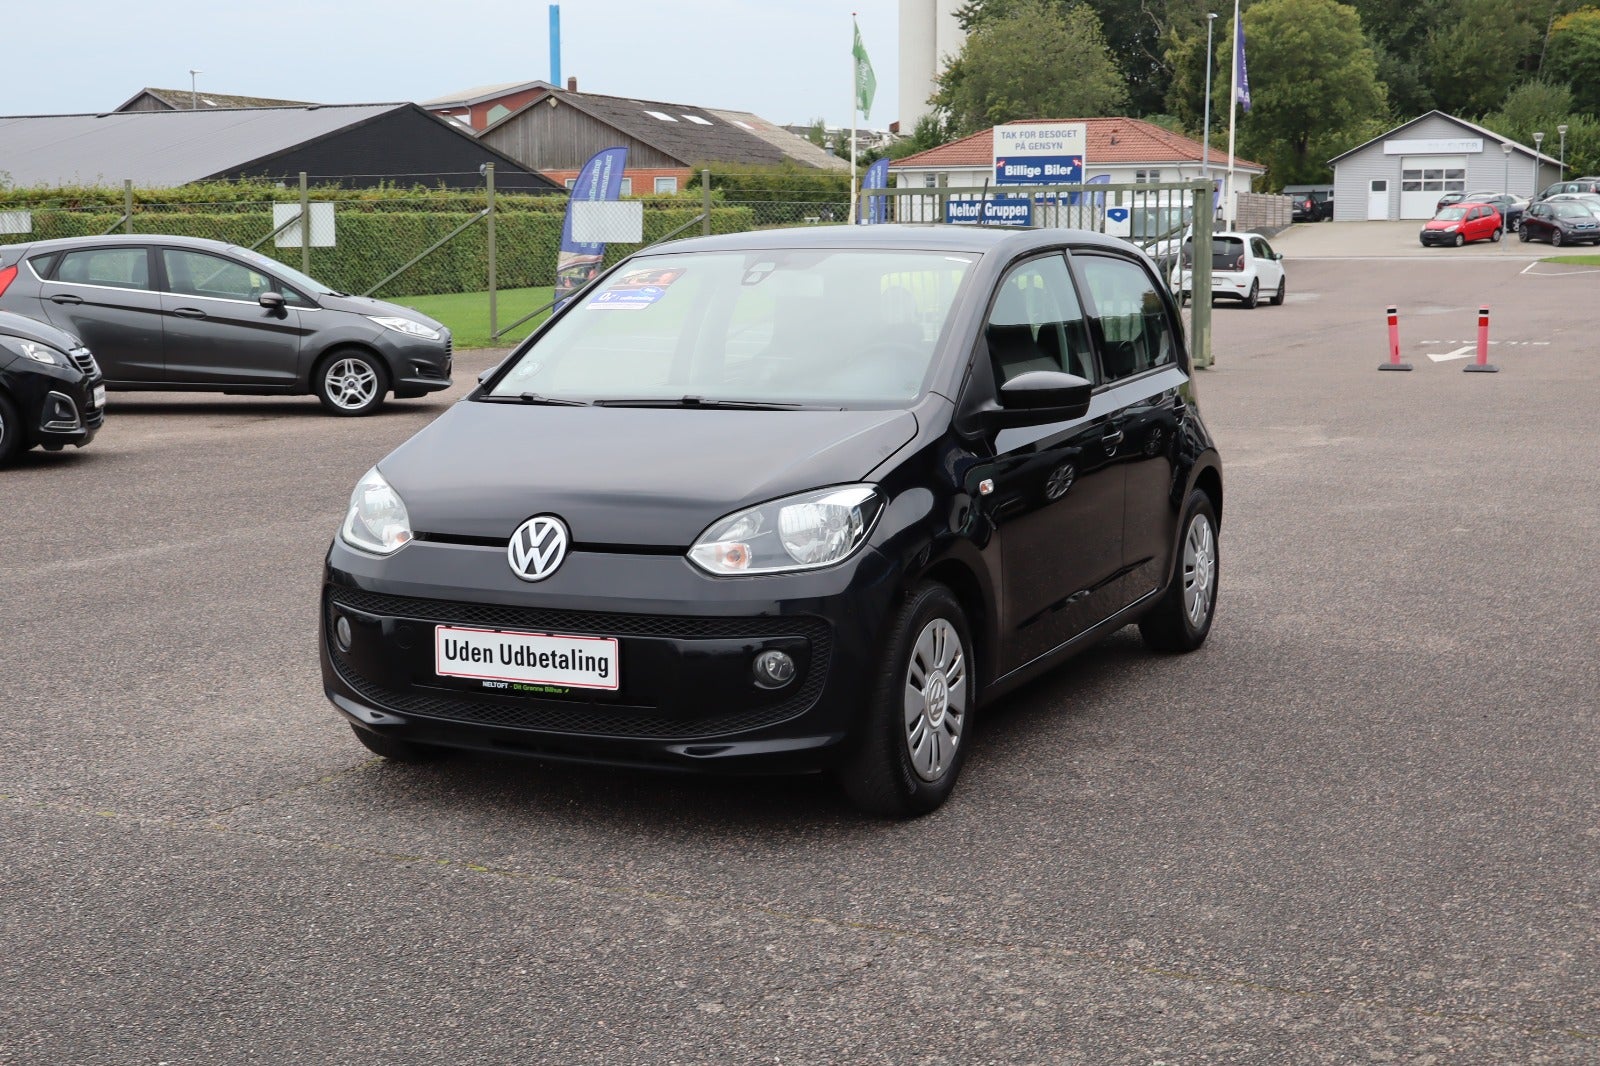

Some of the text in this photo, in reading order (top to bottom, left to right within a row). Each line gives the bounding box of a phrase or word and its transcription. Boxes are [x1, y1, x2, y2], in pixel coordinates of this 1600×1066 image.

[1001, 129, 1078, 139] TAK FOR BESØGET
[1015, 141, 1063, 150] PÅ GENSYN
[1004, 164, 1074, 178] Billige Biler
[949, 202, 1028, 219] Neltof Gruppen
[444, 638, 610, 679] Uden Udbetaling
[482, 680, 509, 689] NELTOFT
